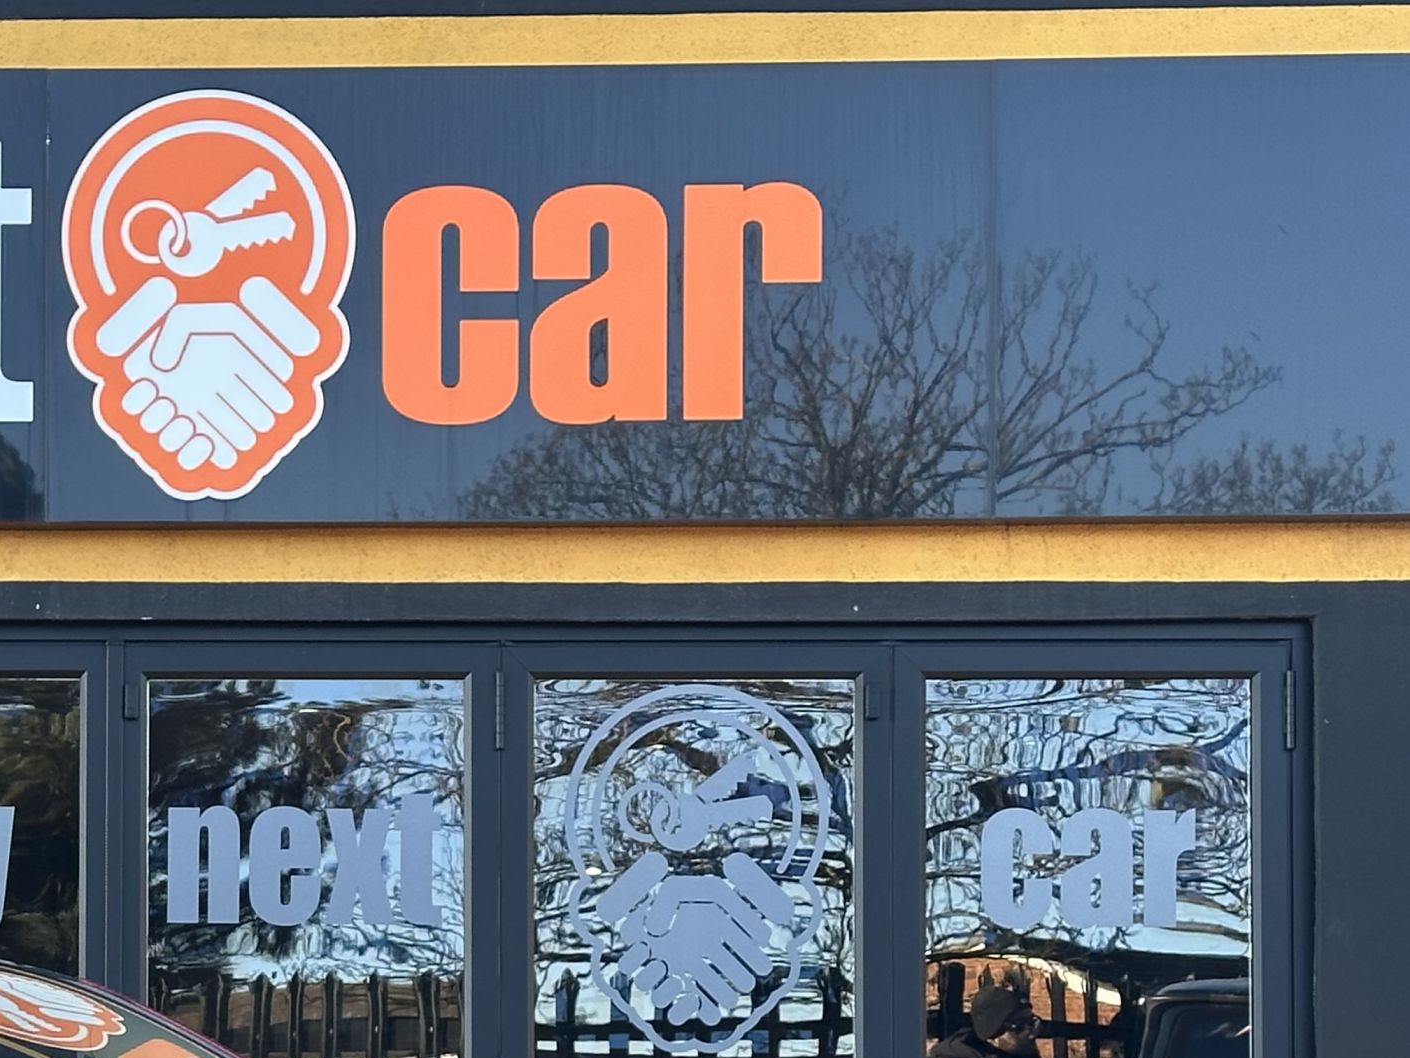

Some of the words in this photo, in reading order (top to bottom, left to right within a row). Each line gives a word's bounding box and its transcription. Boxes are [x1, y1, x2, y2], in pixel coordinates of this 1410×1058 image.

[382, 181, 823, 426] car
[167, 793, 442, 926] next
[981, 807, 1196, 930] car
